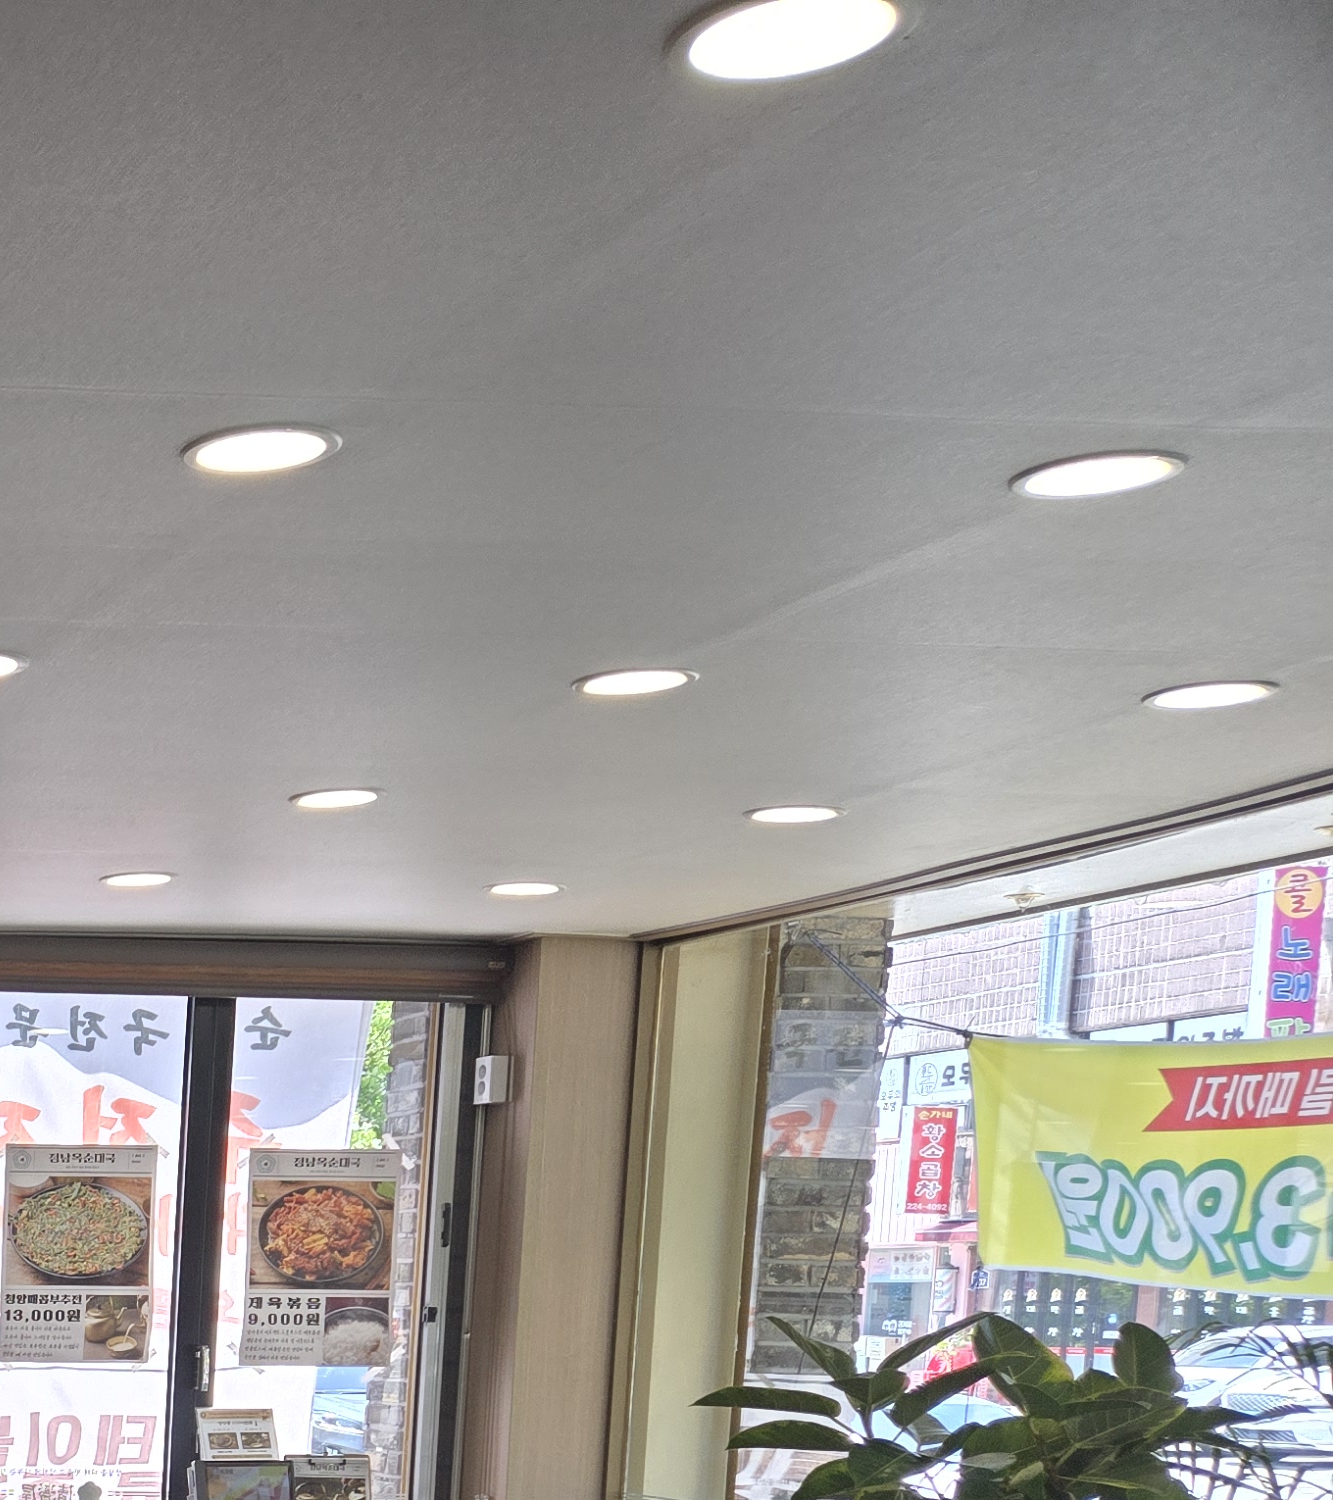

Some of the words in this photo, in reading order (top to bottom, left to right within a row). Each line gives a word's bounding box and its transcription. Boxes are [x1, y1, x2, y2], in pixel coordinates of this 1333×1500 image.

[918, 1110, 953, 1120] 손가네
[914, 1122, 946, 1200] 황소곱창
[906, 1202, 948, 1212] 224-4092
[248, 1296, 322, 1311] 제육볶음
[3, 1309, 81, 1323] 13,000원
[247, 1312, 321, 1326] 9,000원
